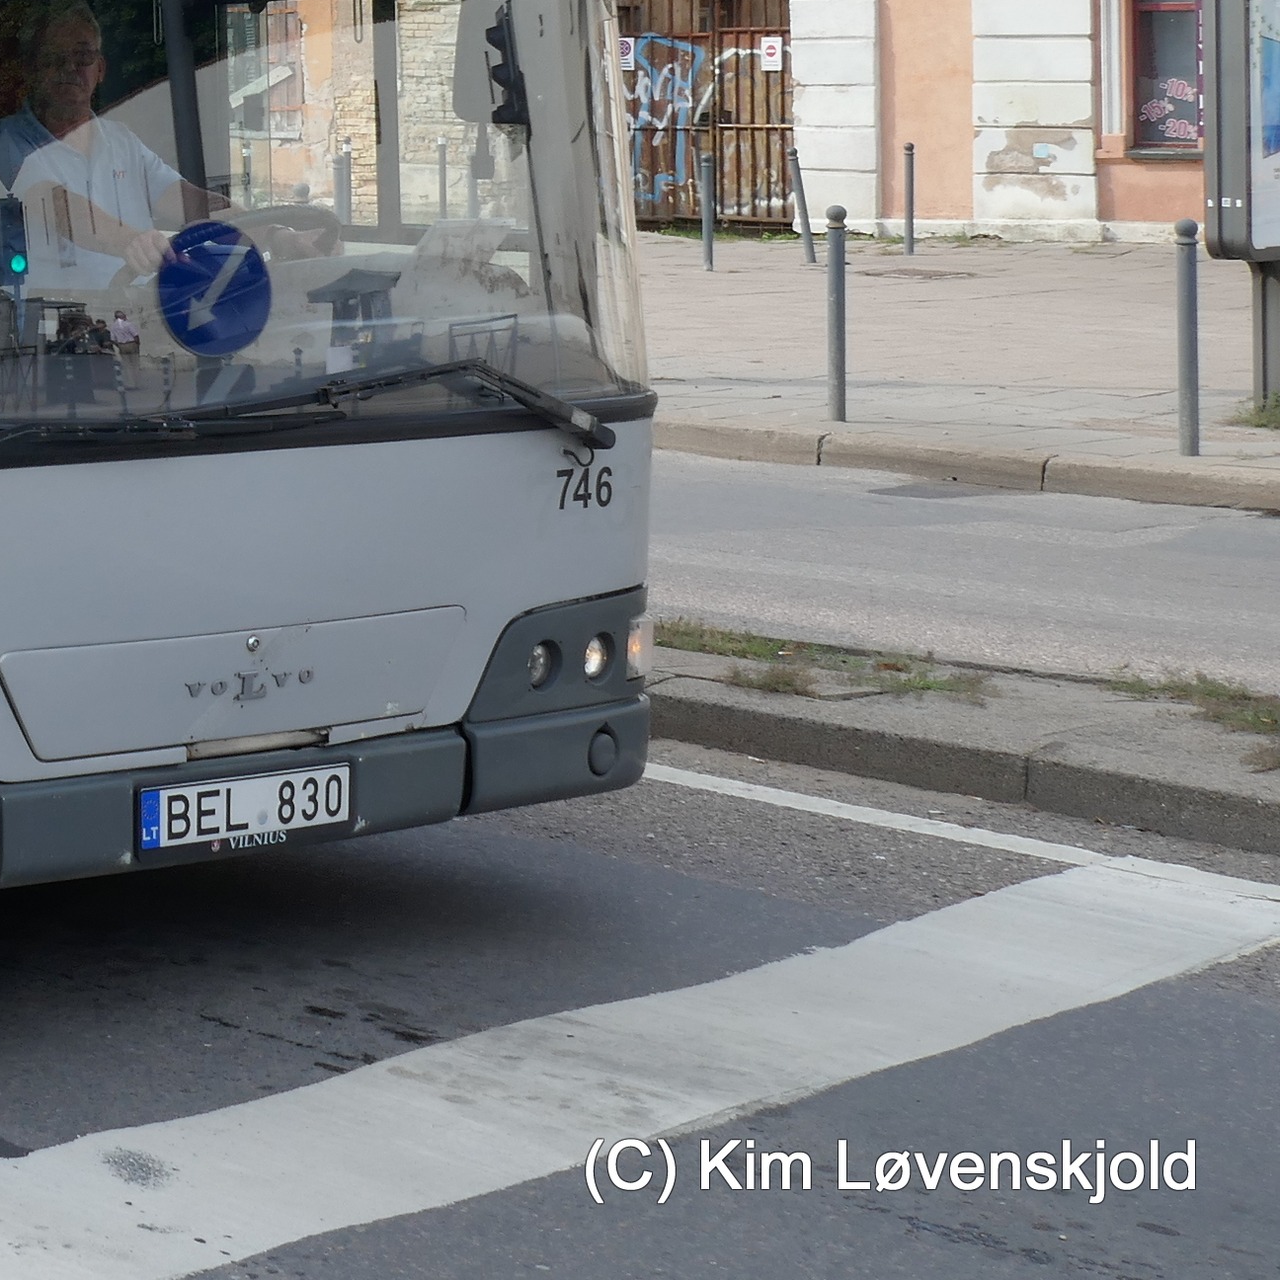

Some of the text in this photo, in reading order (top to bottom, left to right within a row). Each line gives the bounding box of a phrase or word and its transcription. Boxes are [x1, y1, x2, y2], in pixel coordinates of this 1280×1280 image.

[1159, 77, 1197, 103] -10%
[1139, 98, 1174, 122] -15%
[1158, 119, 1198, 140] -20%
[556, 466, 612, 510] 746
[184, 669, 314, 701] VOLVO
[142, 774, 342, 841] LT BEL 830
[228, 829, 287, 850] VILNIUS
